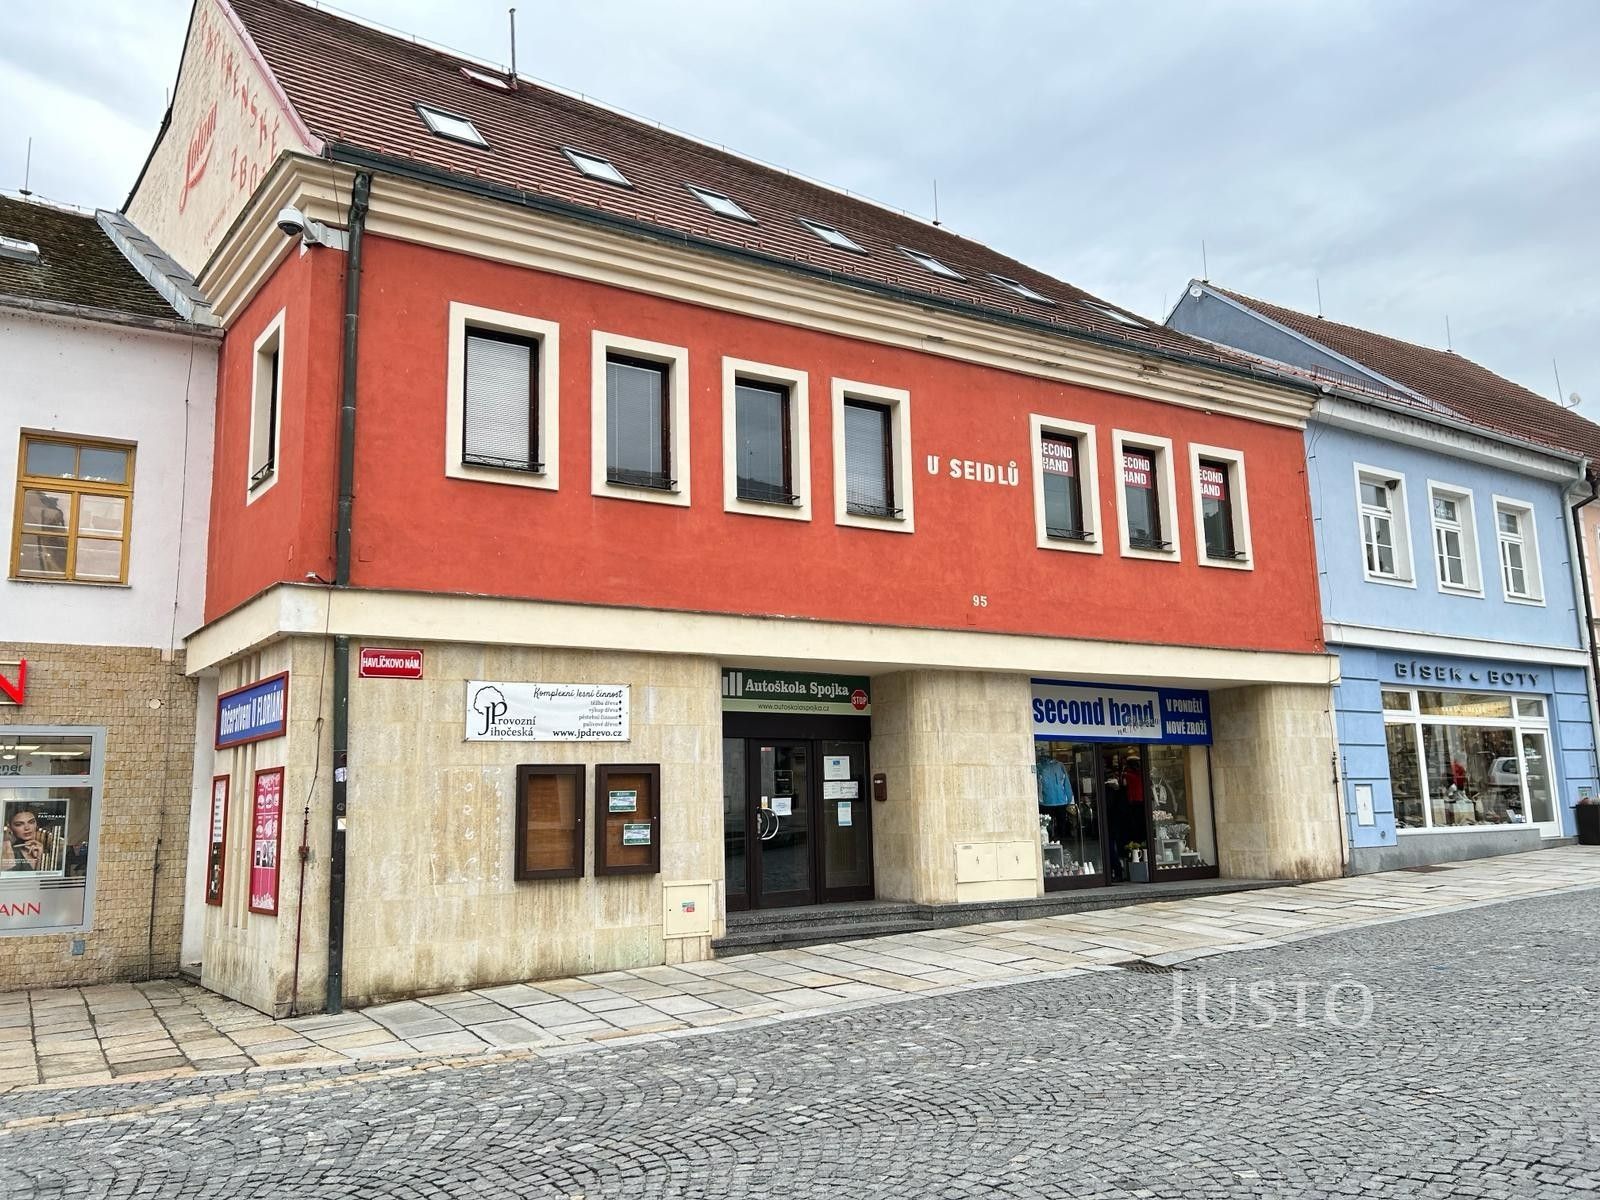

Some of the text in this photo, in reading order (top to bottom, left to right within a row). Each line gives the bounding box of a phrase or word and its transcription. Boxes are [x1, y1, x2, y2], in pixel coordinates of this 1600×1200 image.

[1041, 441, 1073, 459] ECOND
[927, 454, 1019, 487] U SEIDLŮ
[1042, 457, 1069, 473] HAND
[1123, 455, 1150, 472] ECOND
[972, 594, 988, 608] 95
[362, 655, 404, 669] HAVLÍČKOVO
[1394, 660, 1539, 687] BÍSEK BOTY
[533, 687, 623, 700] Komplexní lesní činnost
[745, 679, 850, 698] Autoškola Spojka
[758, 703, 830, 713] www.autoskolaspojka.cz
[852, 696, 867, 705] STOP
[1166, 698, 1203, 714] V PONDĚLÍ
[1032, 697, 1106, 726] second
[1108, 697, 1155, 728] hand
[553, 728, 623, 738] www.jpdrevo.cz
[1166, 719, 1186, 735] NOVÉ
[1187, 720, 1208, 736] ZBOŽÍ
[0, 764, 23, 773] ner
